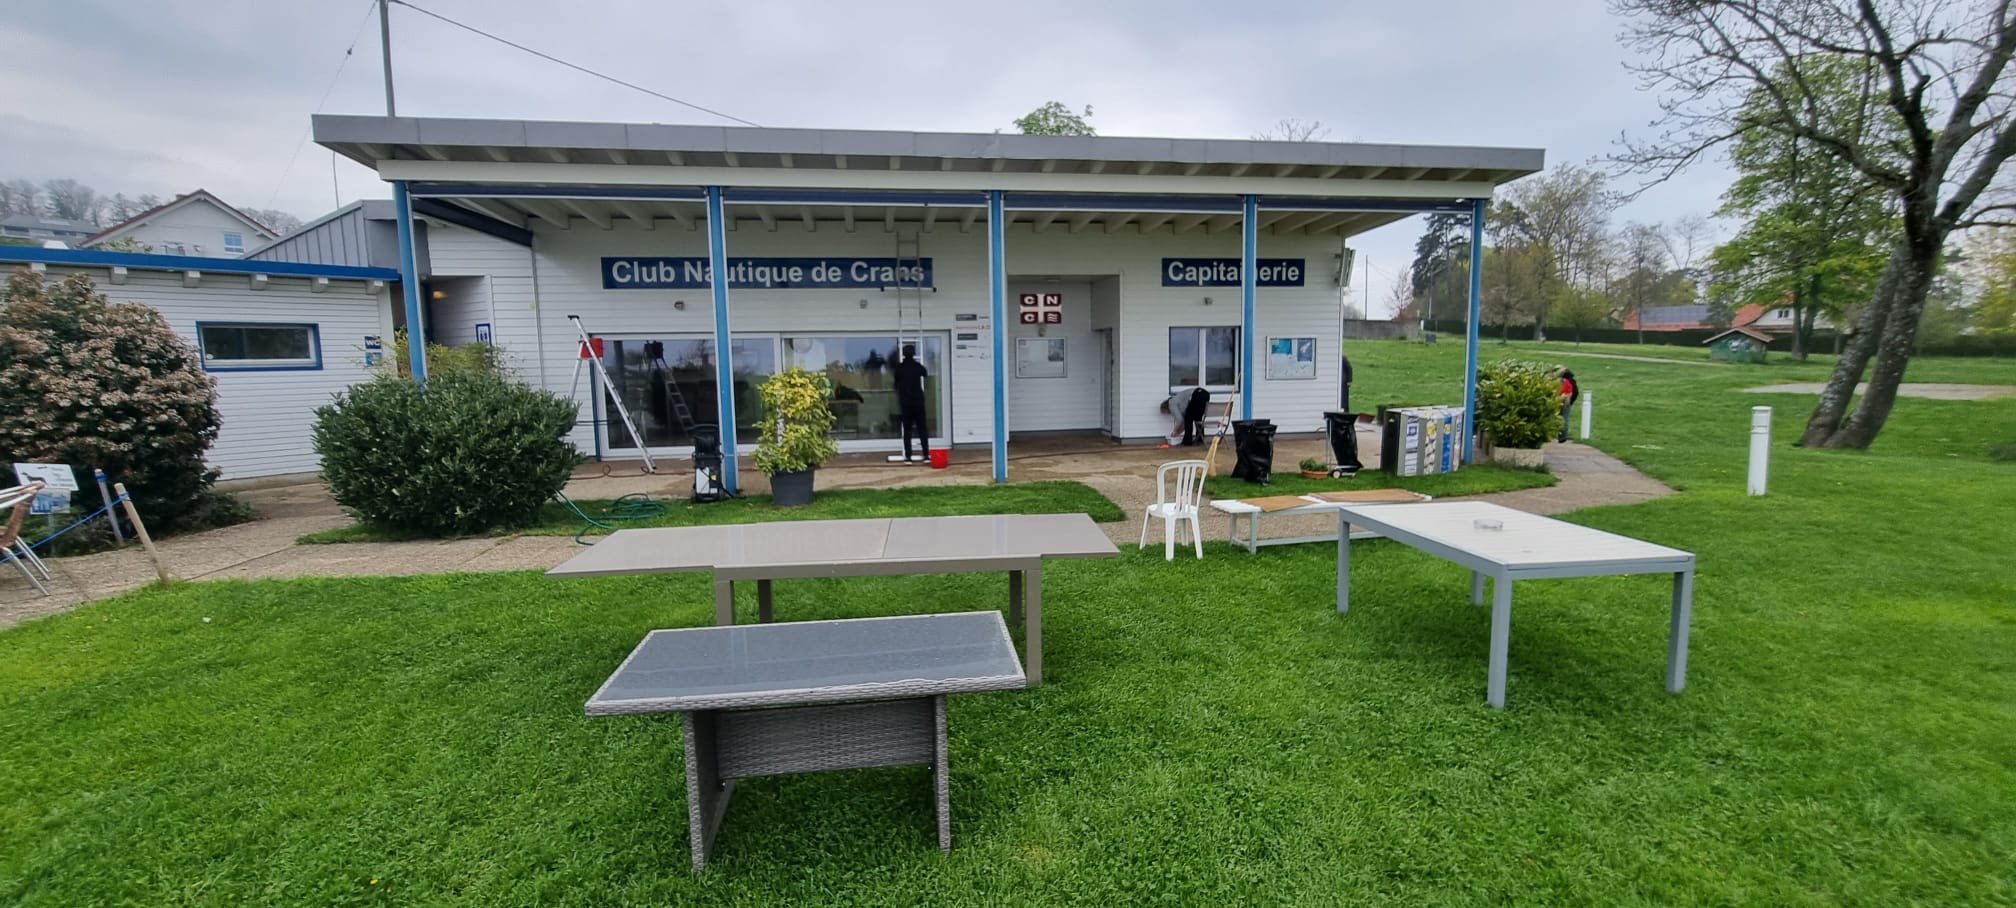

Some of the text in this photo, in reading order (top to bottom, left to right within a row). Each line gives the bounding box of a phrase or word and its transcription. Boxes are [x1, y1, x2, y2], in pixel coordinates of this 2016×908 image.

[612, 261, 675, 283] Club
[811, 261, 842, 282] de
[850, 261, 925, 282] Crans
[1168, 261, 1300, 286] Capitaierie
[1024, 295, 1058, 305] C N
[1024, 313, 1035, 322] C
